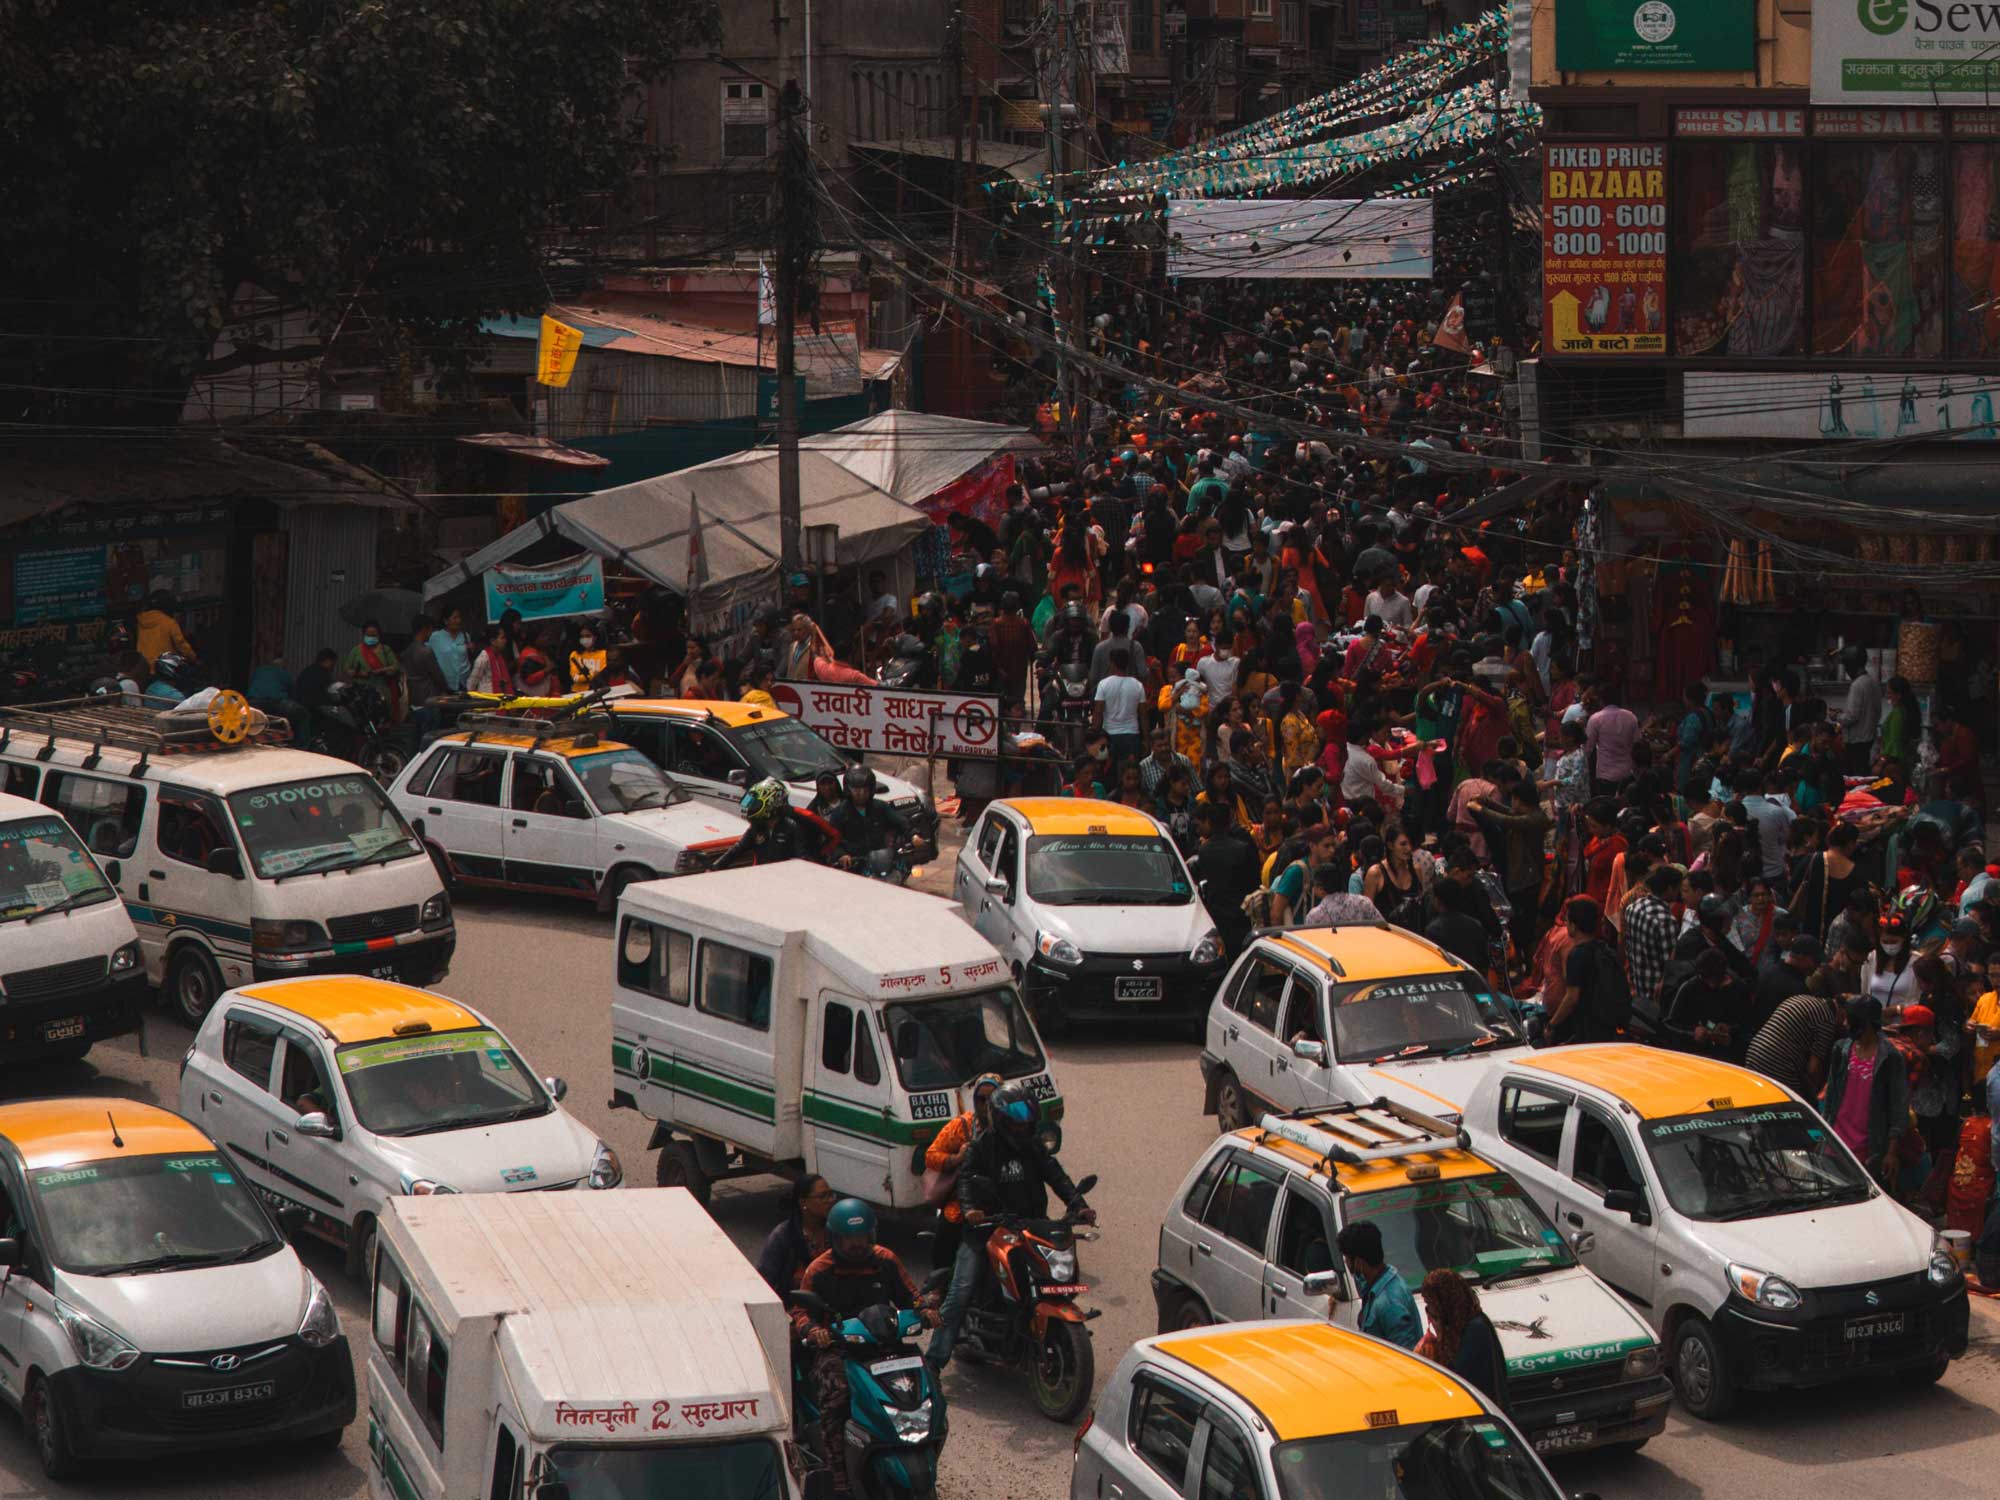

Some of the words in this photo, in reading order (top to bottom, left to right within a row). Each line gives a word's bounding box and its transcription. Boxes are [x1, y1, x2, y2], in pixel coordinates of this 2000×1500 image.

[1677, 111, 1719, 120] FIXED
[1723, 110, 1803, 133] SALE
[1815, 111, 1856, 121] FIXED
[1861, 111, 1942, 134] SALE
[1677, 122, 1720, 132] PRICE
[1815, 123, 1857, 133] PRICE
[1548, 147, 1601, 168] FIXED
[1606, 146, 1663, 168] PRICE
[1549, 169, 1664, 199] BAZAAR
[1615, 204, 1666, 227] 600
[1615, 232, 1666, 255] 1000
[1561, 336, 1593, 350] जाने
[1598, 336, 1629, 350] बाटो
[810, 687, 873, 716] सवारी
[883, 696, 946, 721] साधन
[952, 744, 963, 753] NO
[964, 745, 998, 755] PARKING
[267, 782, 348, 805] TOYOTA
[939, 966, 952, 985] 5
[1373, 980, 1465, 999] SUZUKI
[1406, 993, 1429, 1004] TAXI
[913, 1104, 948, 1119] 4819
[1780, 1111, 1803, 1121] जय
[164, 1157, 224, 1172] सुन्दर
[1508, 1354, 1557, 1372] Love
[1563, 1341, 1623, 1361] Nepal
[651, 1399, 672, 1431] 2
[680, 1398, 760, 1428] सुन्धारा
[1371, 1410, 1397, 1426] TAXI
